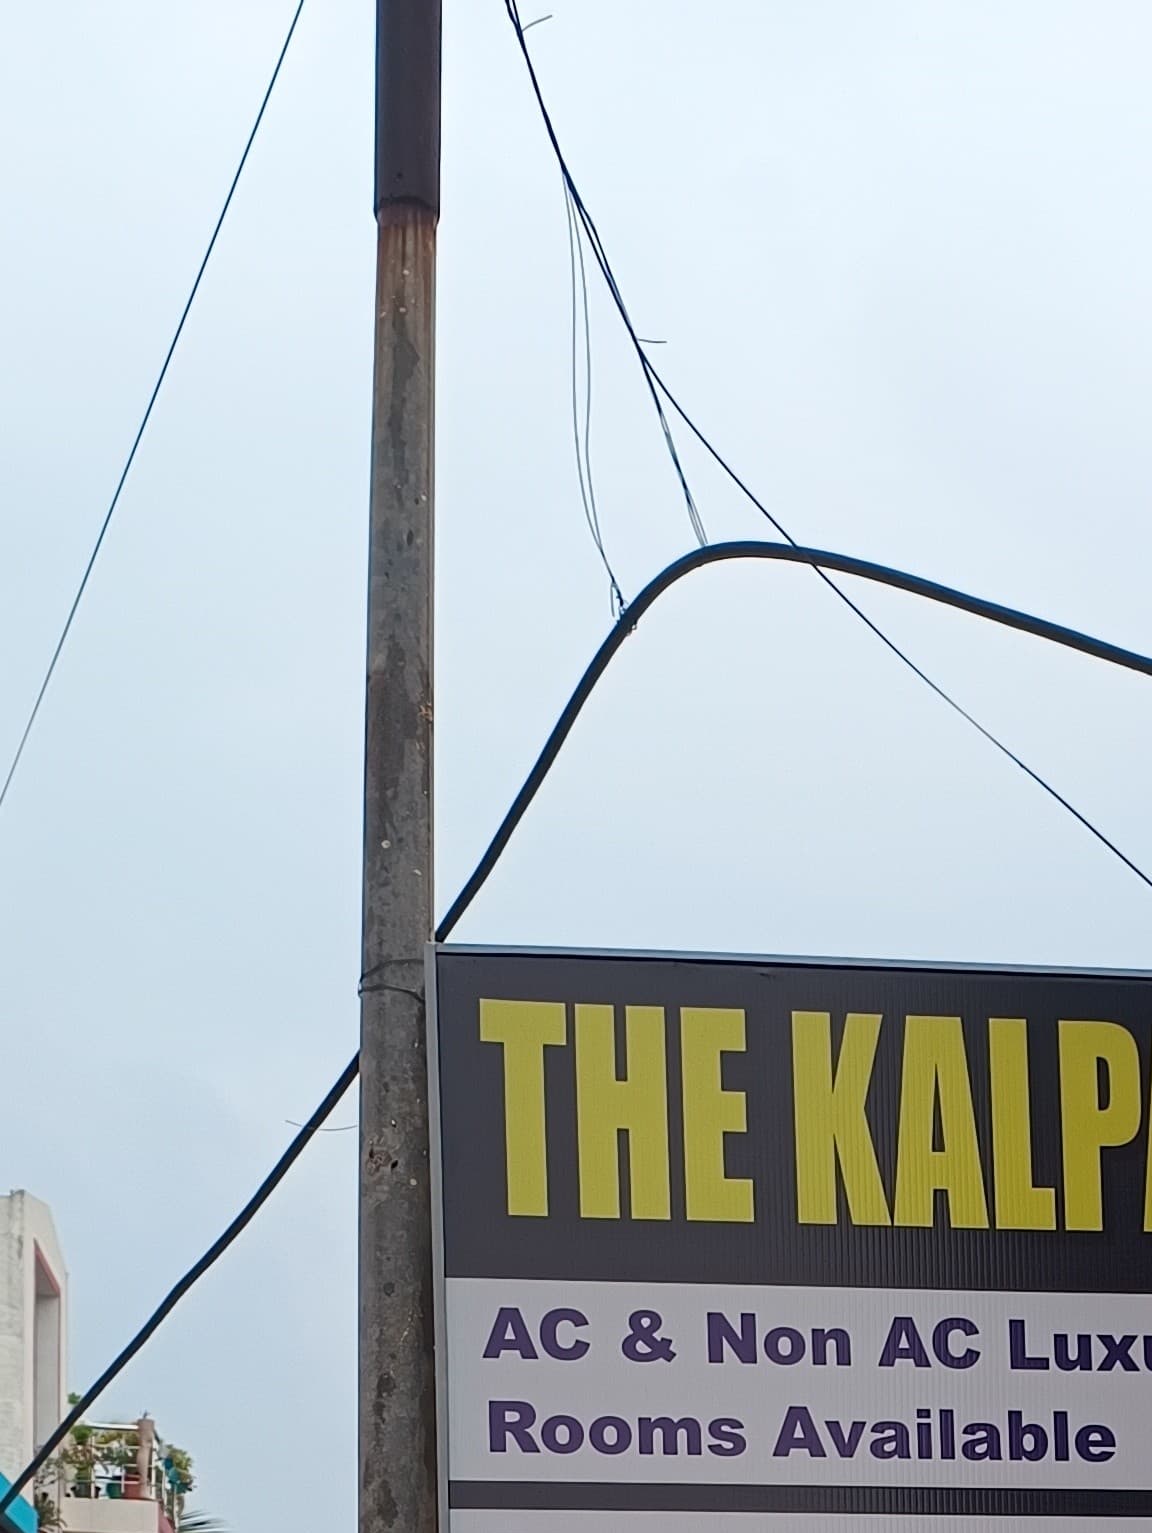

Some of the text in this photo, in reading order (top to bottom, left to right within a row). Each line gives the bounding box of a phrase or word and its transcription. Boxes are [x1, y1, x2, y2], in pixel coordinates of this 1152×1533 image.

[480, 998, 754, 1222] THE
[482, 1307, 590, 1360] AC
[621, 1309, 676, 1363] &
[707, 1312, 852, 1366] Non
[878, 1317, 981, 1370] AC
[488, 1400, 1117, 1462] Rooms Available
